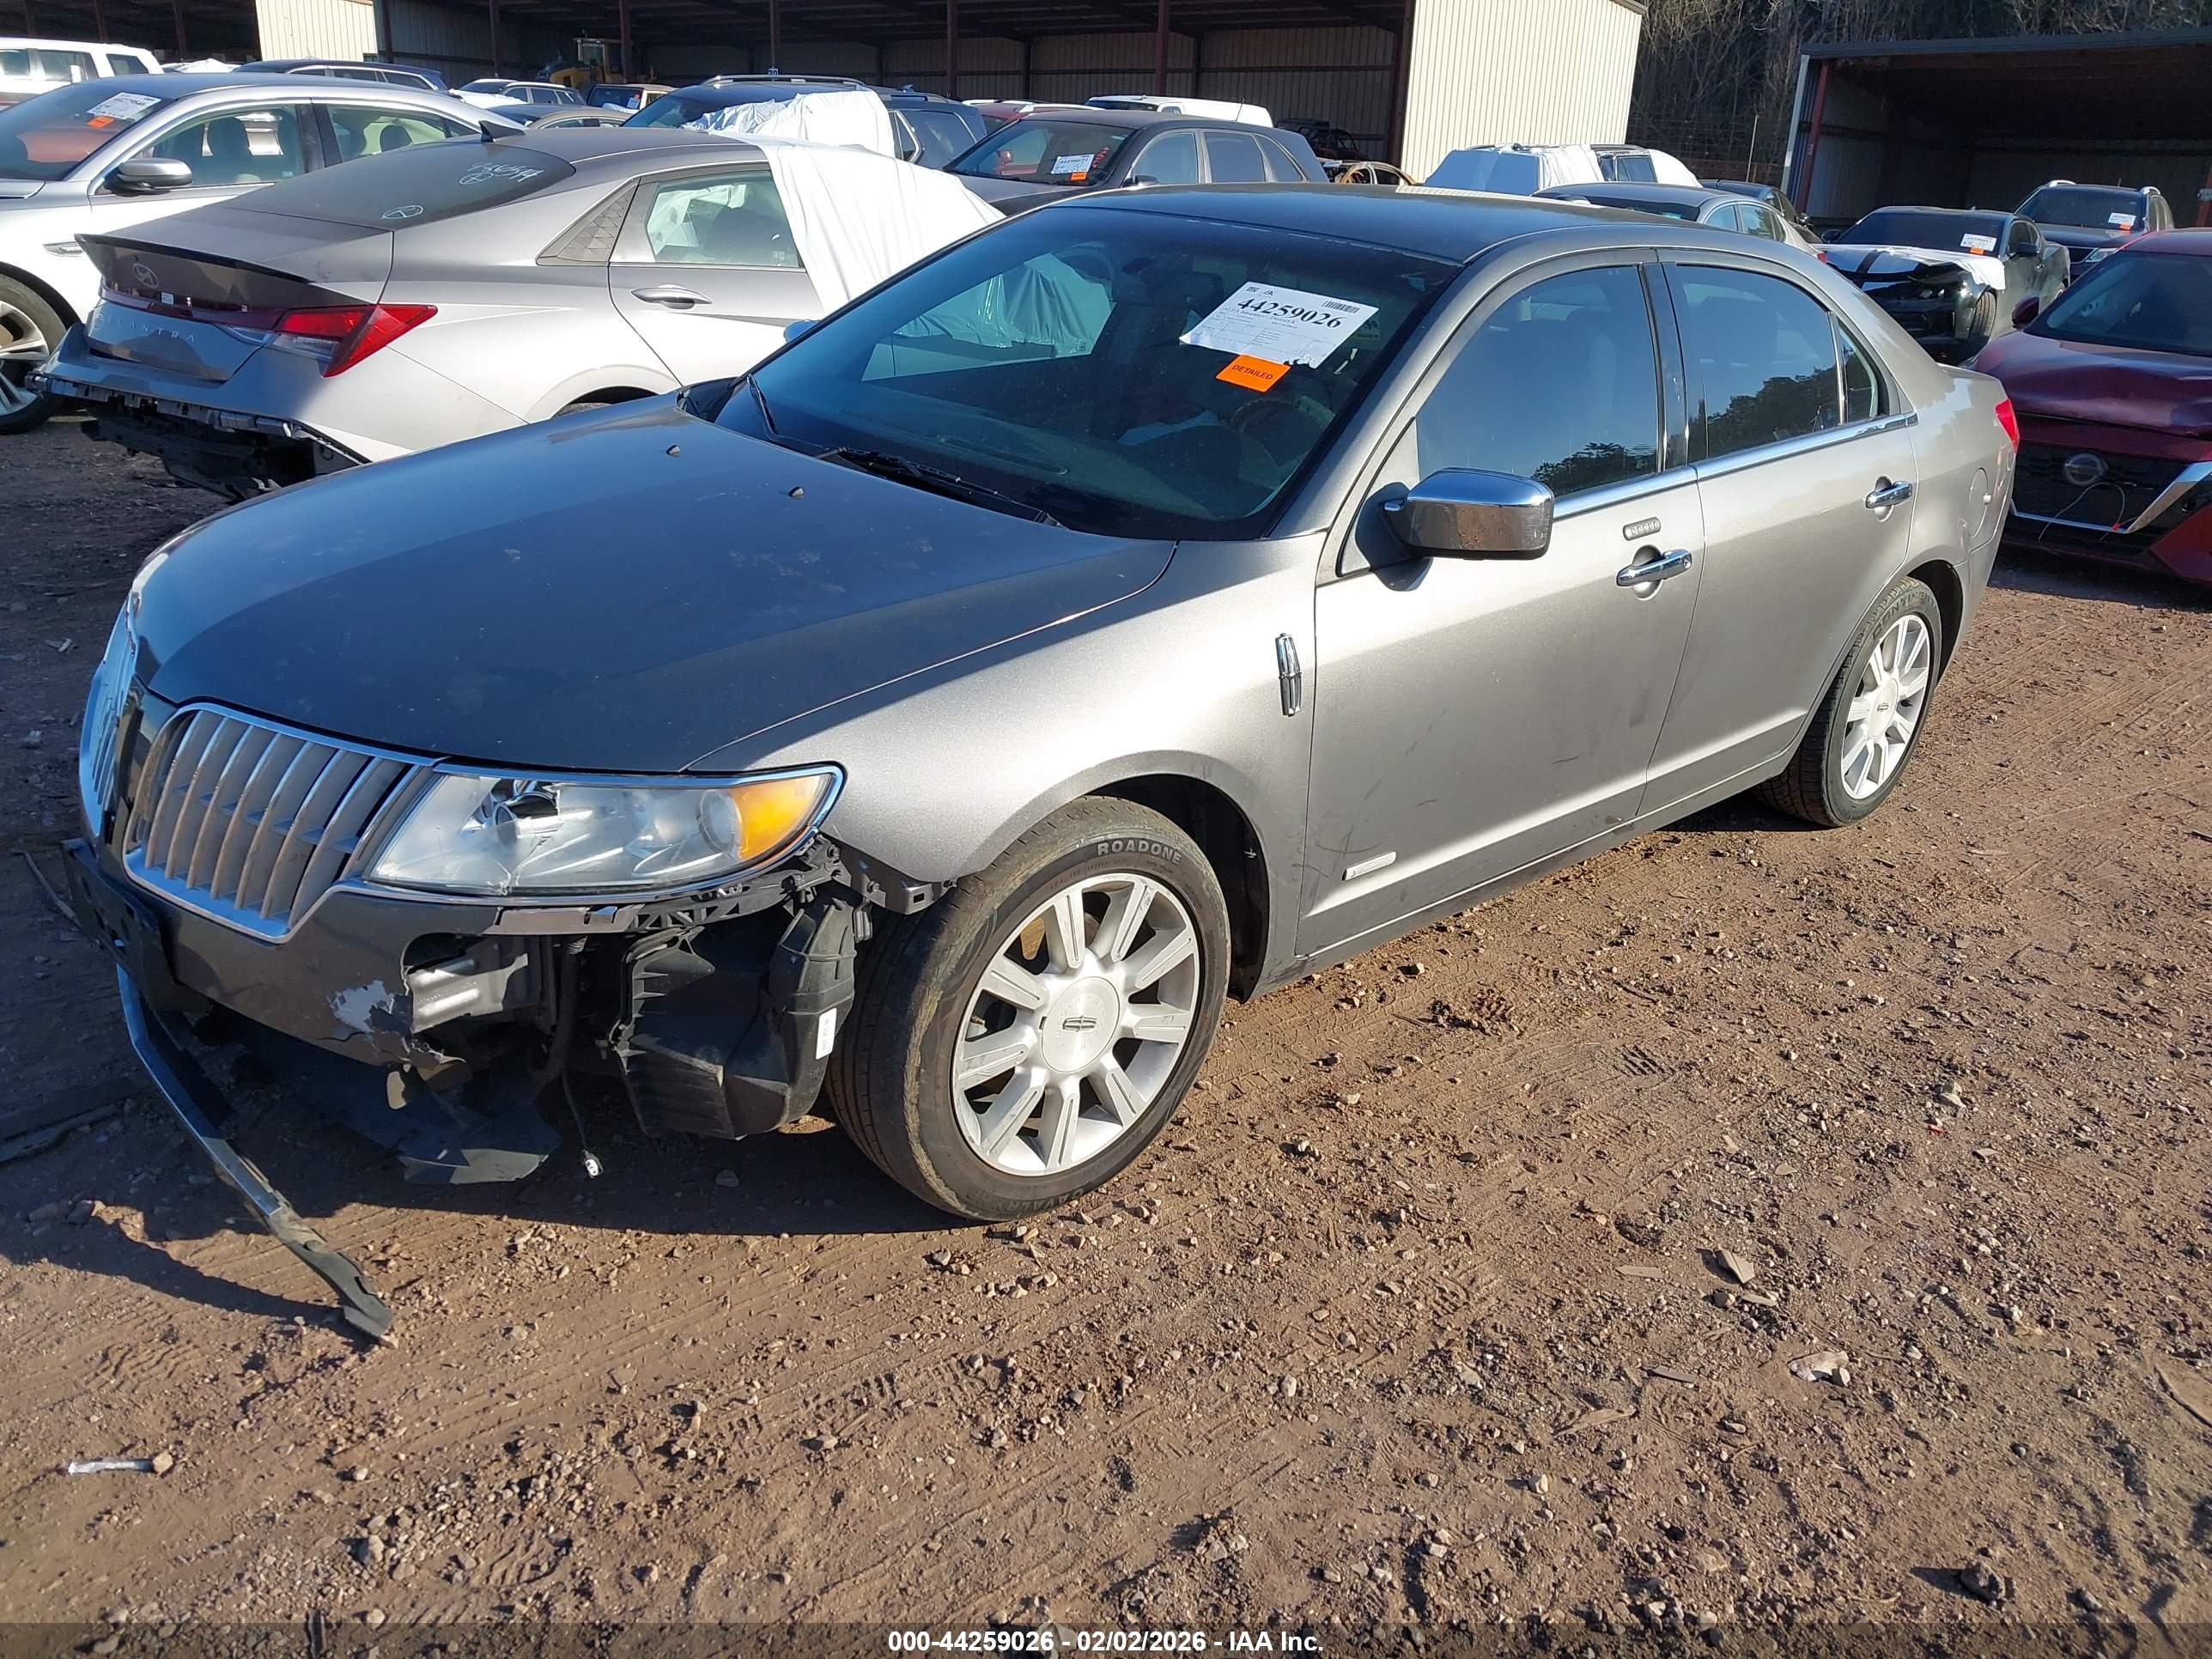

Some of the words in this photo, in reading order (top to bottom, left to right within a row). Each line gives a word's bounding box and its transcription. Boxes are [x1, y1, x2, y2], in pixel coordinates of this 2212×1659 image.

[1237, 298, 1347, 329] 44259026
[107, 315, 196, 342] ELANTRA
[1231, 364, 1273, 380] DETAILED
[1097, 840, 1182, 866] ROADONE
